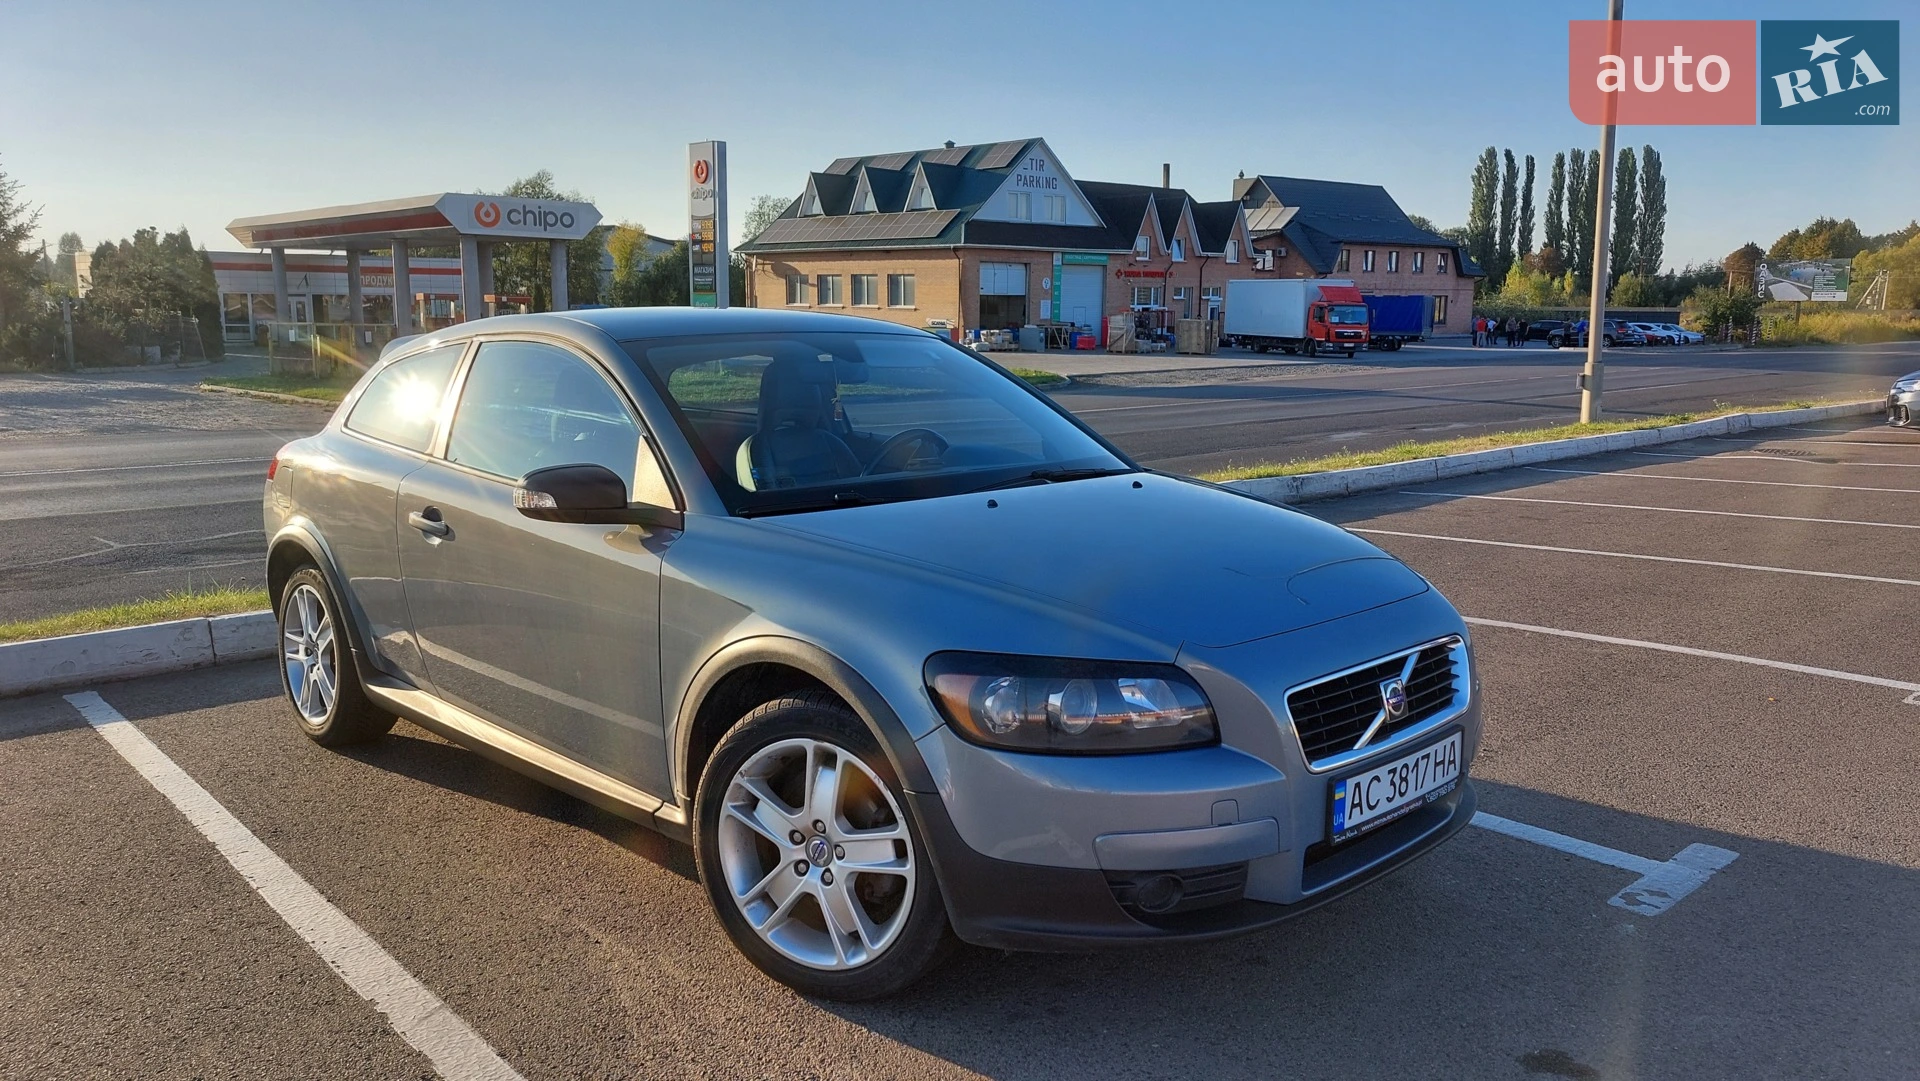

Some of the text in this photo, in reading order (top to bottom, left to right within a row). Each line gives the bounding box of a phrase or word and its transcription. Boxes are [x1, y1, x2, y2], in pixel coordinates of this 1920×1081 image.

[1016, 173, 1058, 190] PARKING
[506, 204, 575, 232] chipo
[1333, 813, 1344, 827] UA
